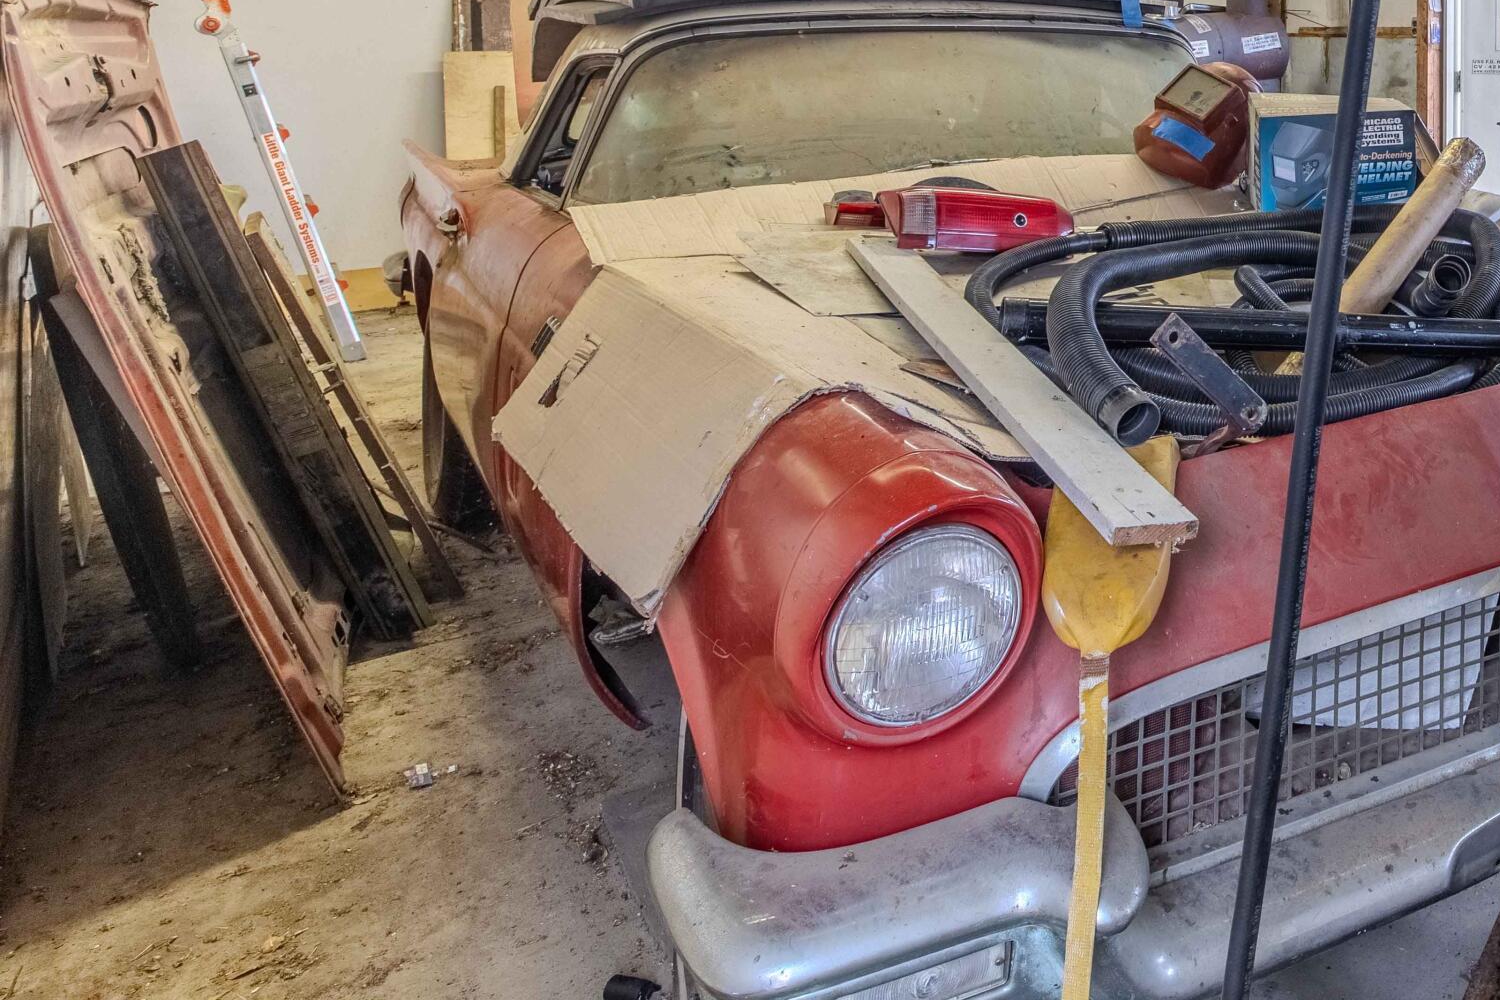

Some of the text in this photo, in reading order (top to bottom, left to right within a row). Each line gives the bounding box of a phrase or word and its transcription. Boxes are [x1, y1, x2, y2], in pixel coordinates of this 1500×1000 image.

[1362, 124, 1404, 132] LECTRIC
[1363, 117, 1402, 126] HICAGO
[1360, 149, 1413, 161] to-Darkening
[1357, 160, 1414, 174] ELDING
[1356, 171, 1413, 185] HELMET
[263, 133, 320, 264] Little Giant Ladder Systems
